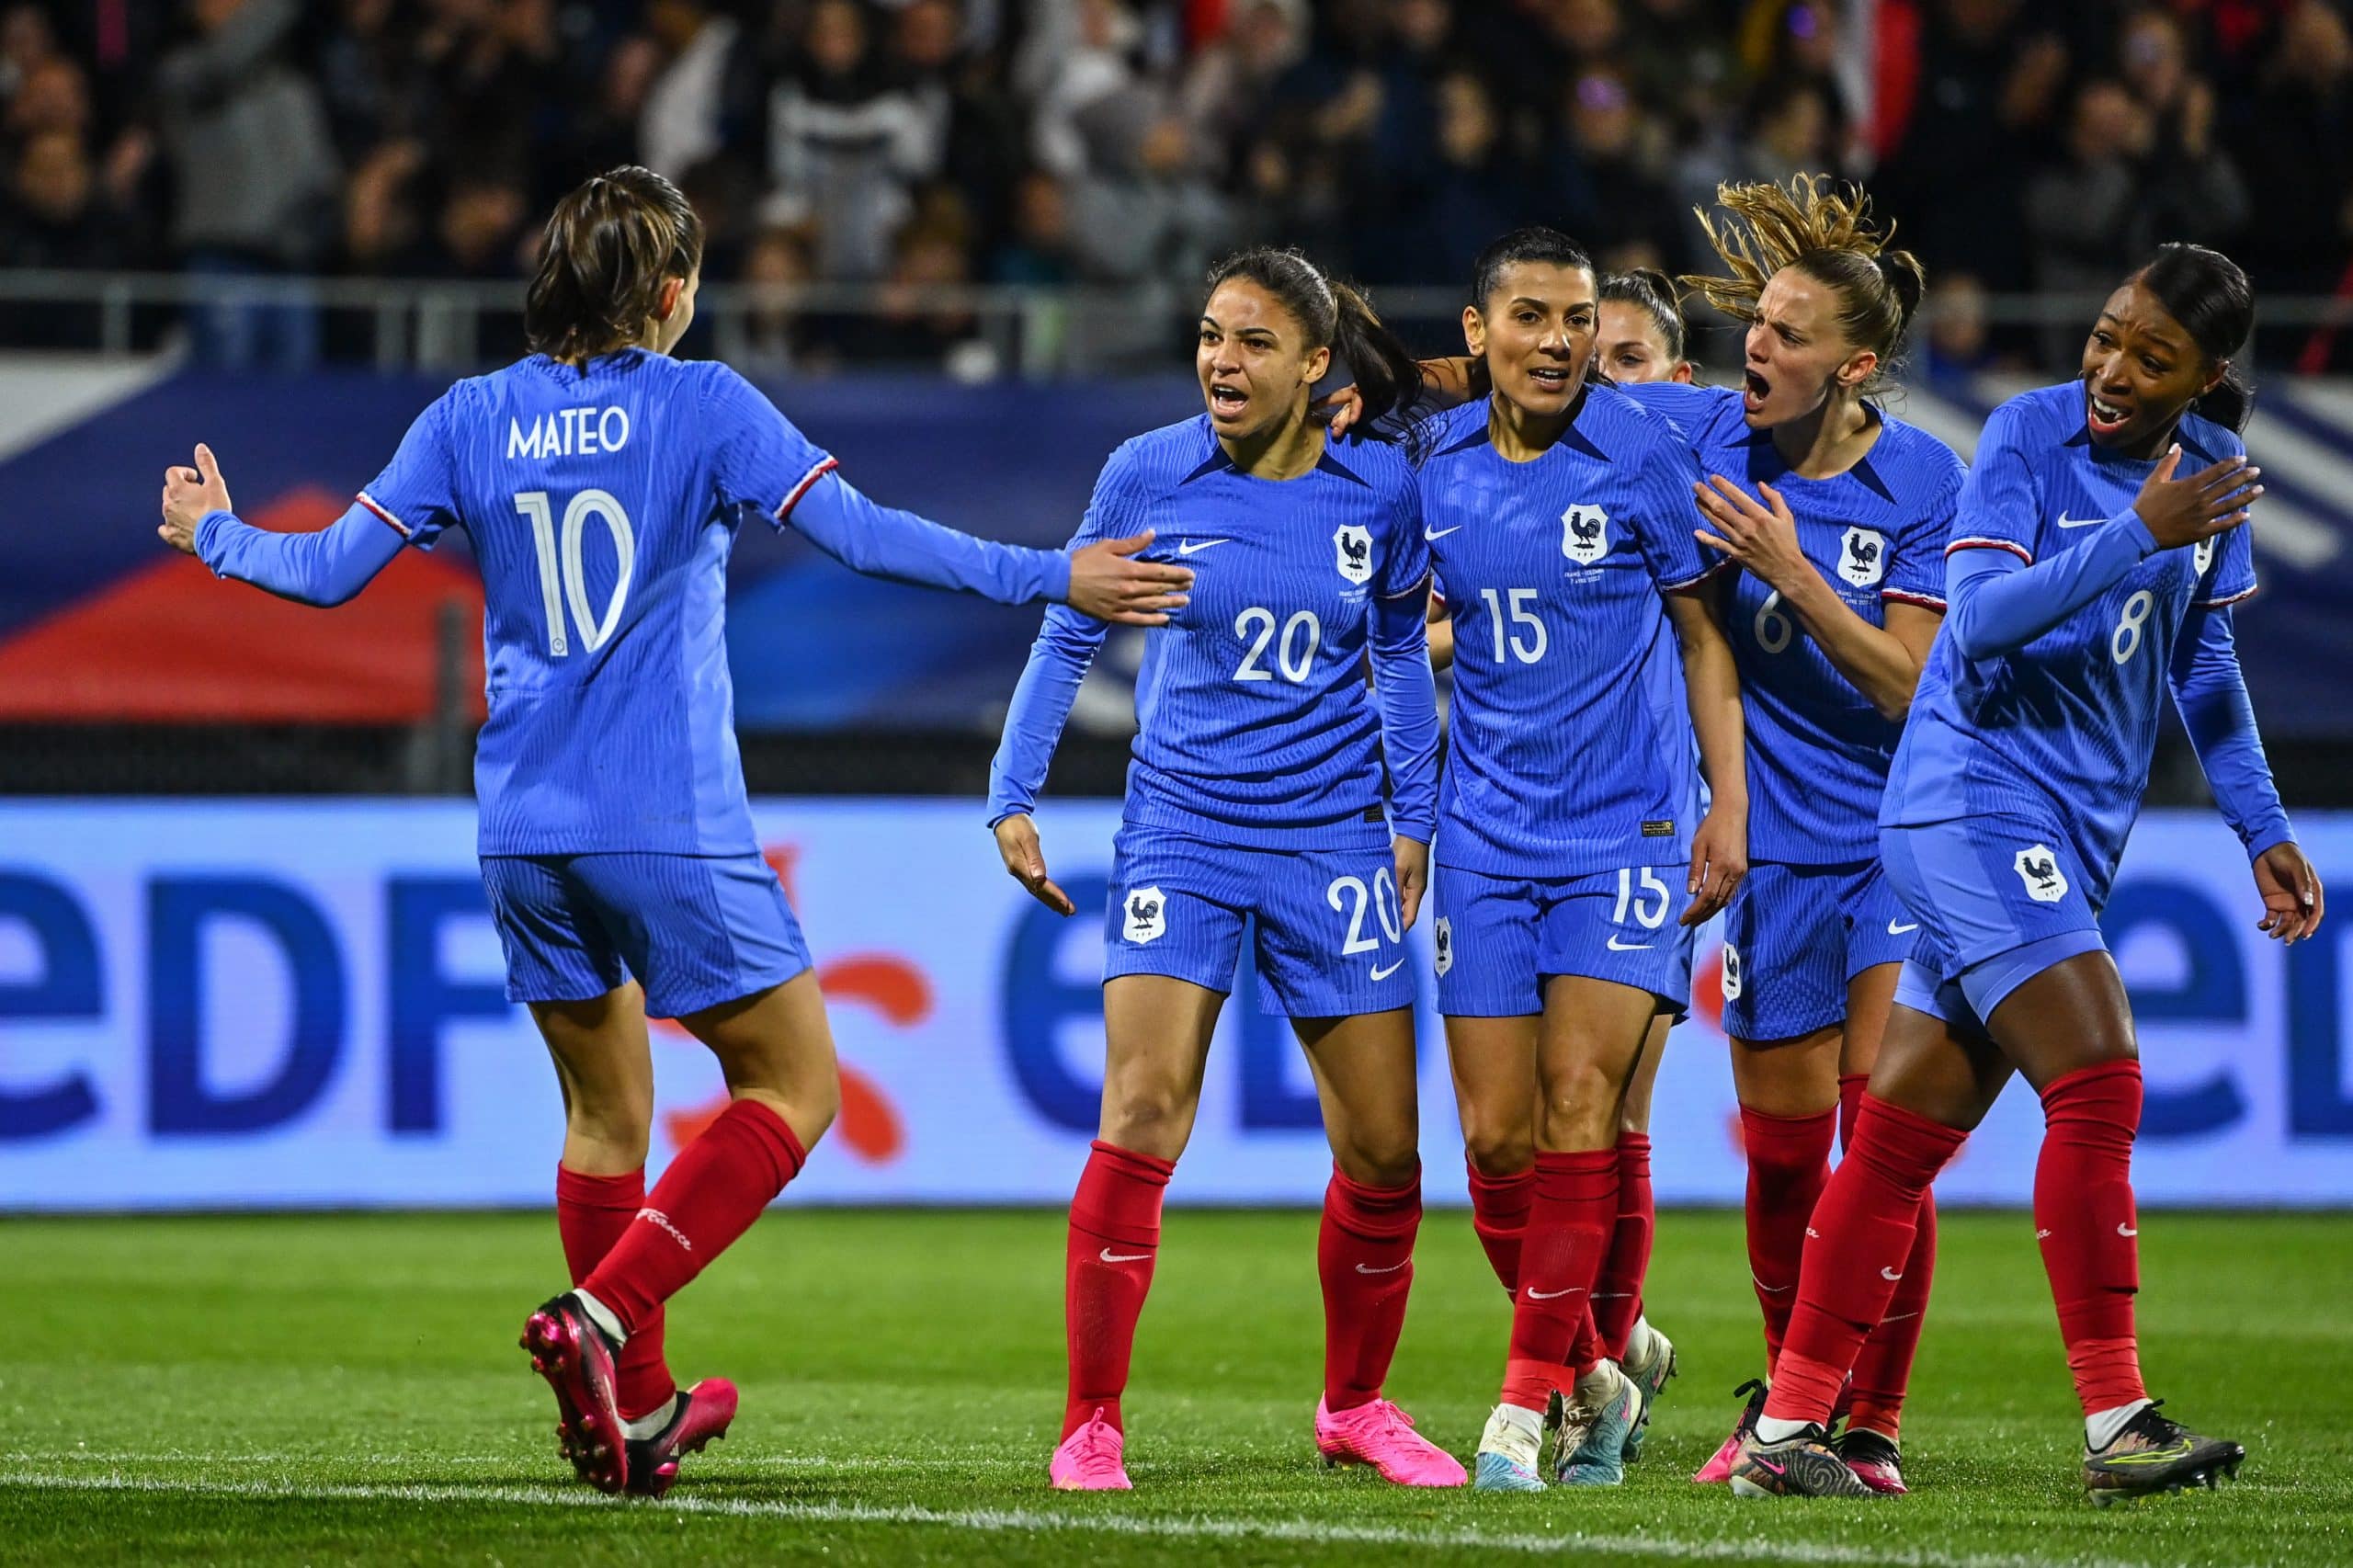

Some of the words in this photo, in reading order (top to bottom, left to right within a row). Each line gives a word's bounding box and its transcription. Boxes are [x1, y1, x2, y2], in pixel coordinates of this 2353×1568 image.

[506, 405, 630, 459] MATEO
[514, 489, 635, 656] 10
[1233, 607, 1321, 682] 20
[1481, 588, 1548, 664] 15
[1754, 589, 1792, 653] 6
[2111, 589, 2154, 665] 8
[1326, 867, 1402, 956] 20
[1613, 867, 1670, 928] 15
